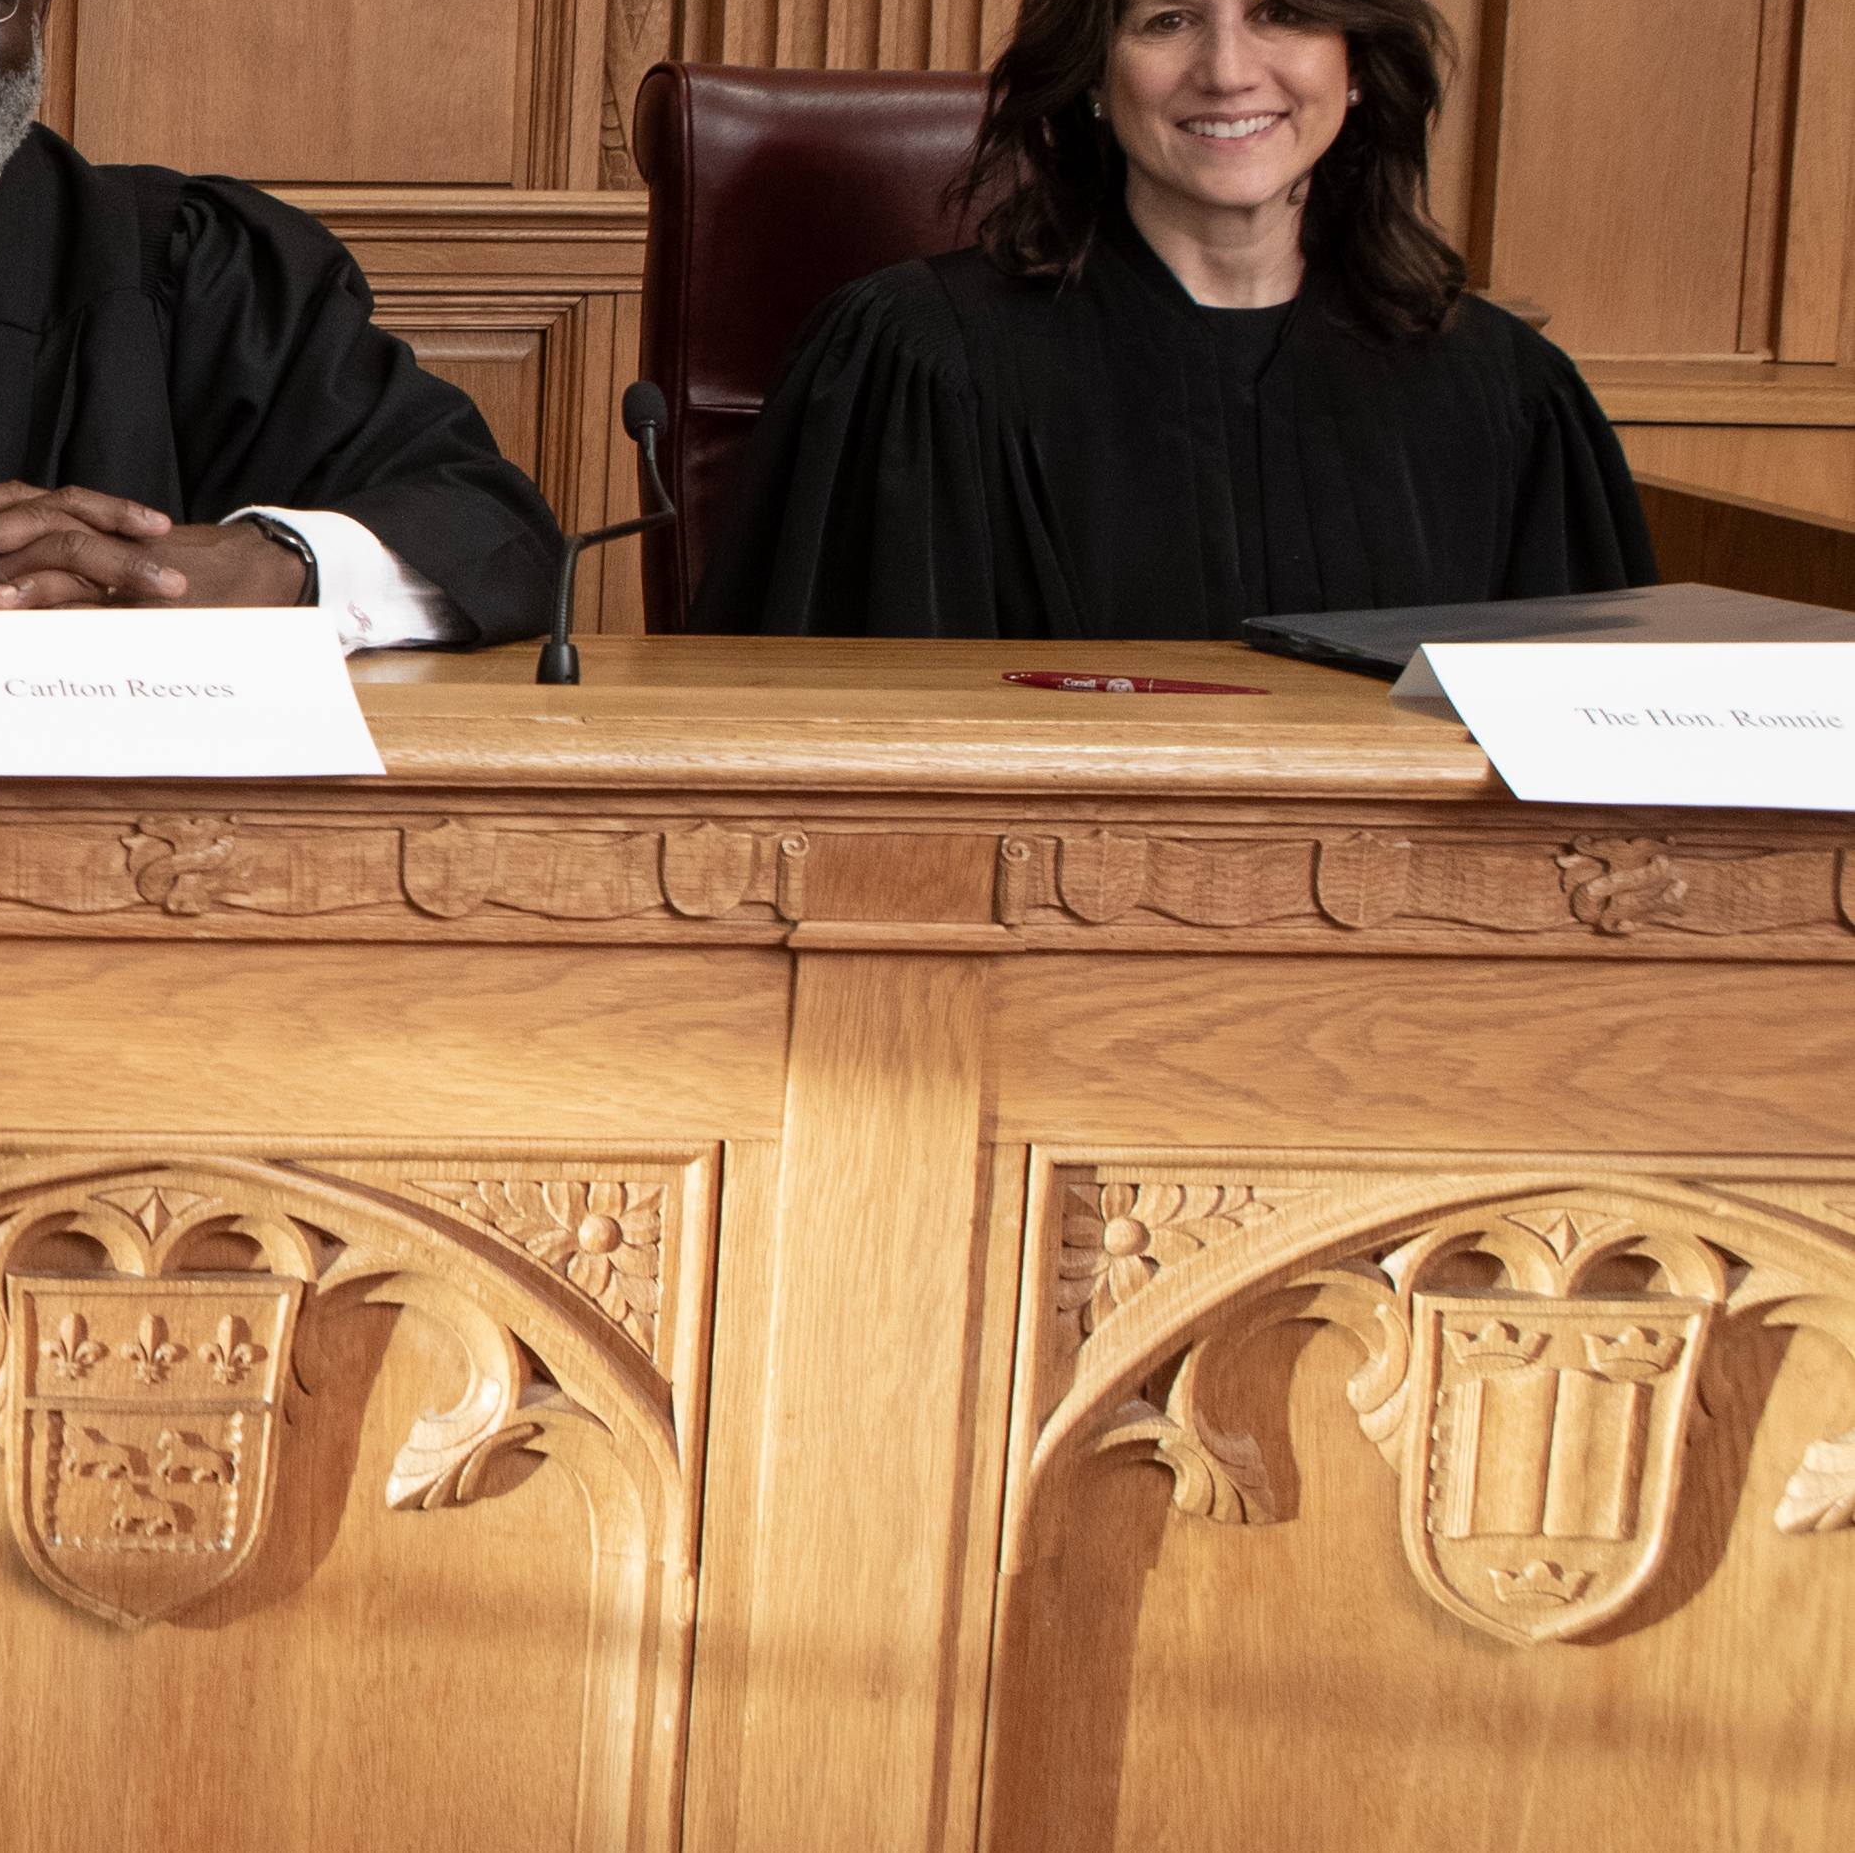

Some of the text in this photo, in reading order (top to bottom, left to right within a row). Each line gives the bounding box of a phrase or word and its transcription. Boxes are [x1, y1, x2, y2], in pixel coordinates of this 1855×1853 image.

[4, 678, 116, 698] Carlton
[126, 678, 235, 698] Reeves
[1574, 707, 1844, 729] The Hon. Ronnie
